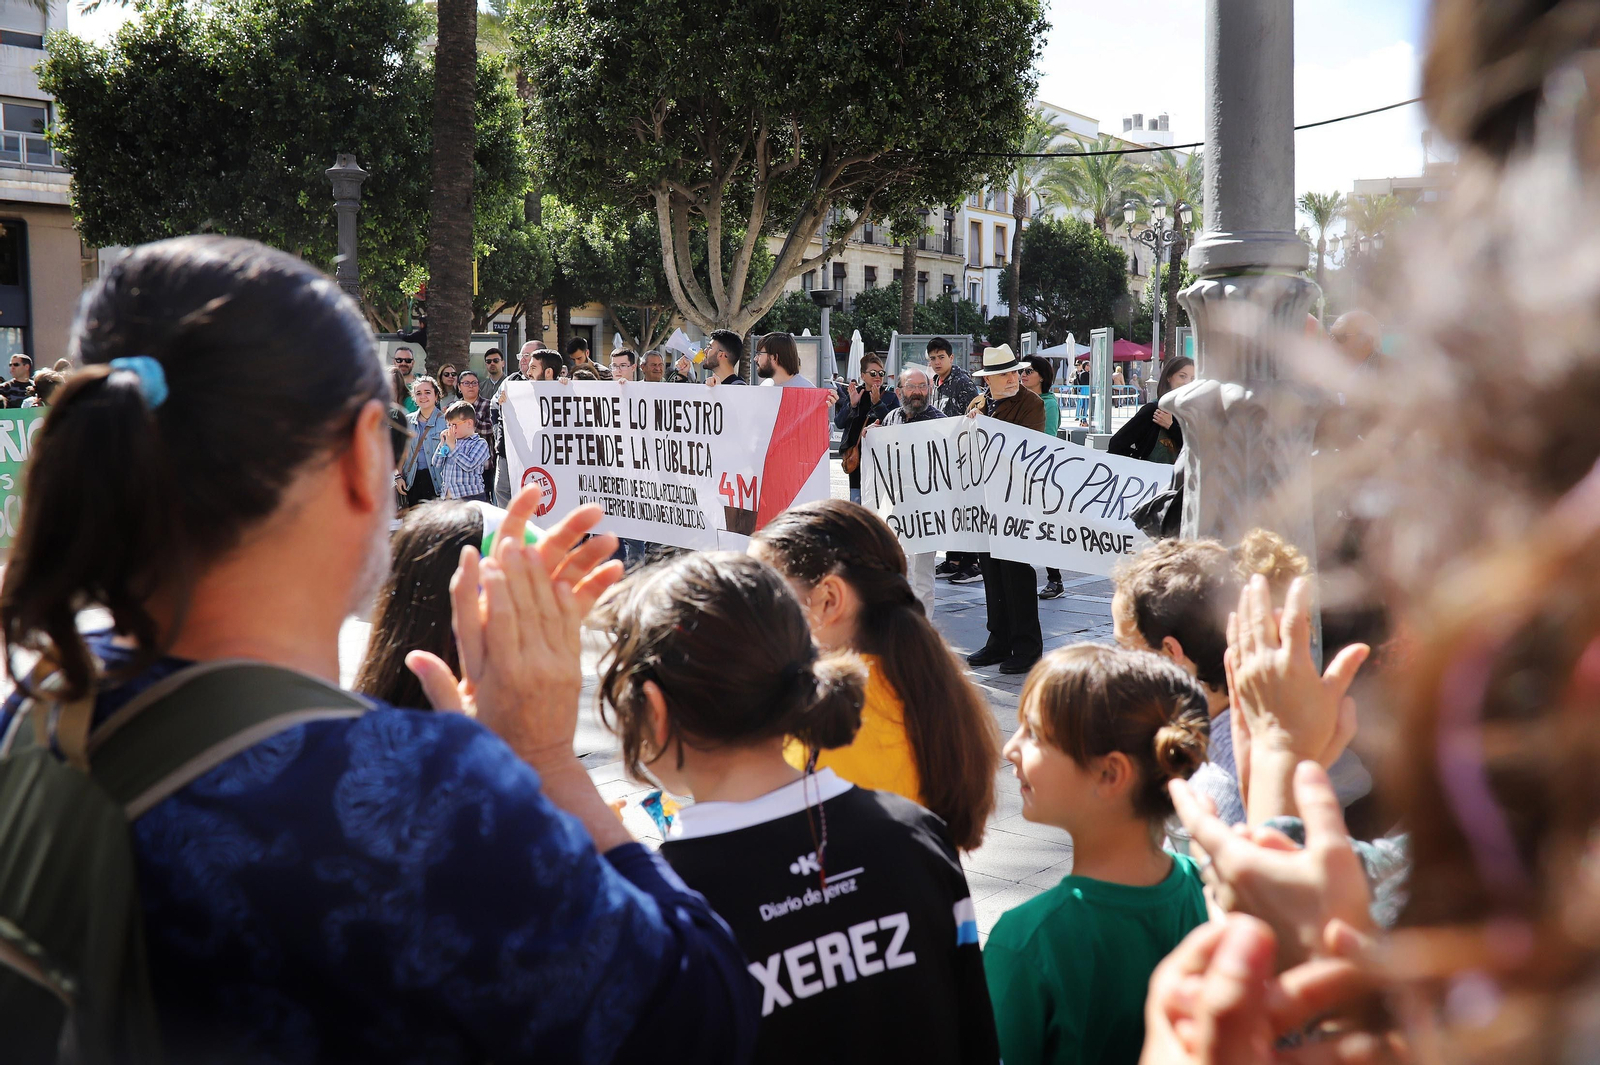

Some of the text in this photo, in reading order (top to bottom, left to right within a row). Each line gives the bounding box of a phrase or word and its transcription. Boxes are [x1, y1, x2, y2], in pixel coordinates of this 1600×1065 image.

[539, 396, 723, 435] DEFIENDE LO NUESTRO
[541, 433, 713, 478] DEFIENDE LA PÚBLICA
[578, 474, 699, 506] NO AL DECRETO DE ESCOLARIZACIÓN
[719, 472, 758, 511] 4M
[911, 438, 952, 495] UN
[1005, 439, 1085, 515] MÁS
[626, 499, 636, 519] DE
[636, 502, 670, 524] UNIDADES
[1003, 516, 1034, 540] QUE
[1035, 521, 1057, 542] SE
[1060, 525, 1078, 545] LO
[1080, 526, 1136, 555] PAGUE
[758, 894, 804, 922] Diario
[803, 886, 824, 907] de
[747, 911, 917, 1017] XEREZ
